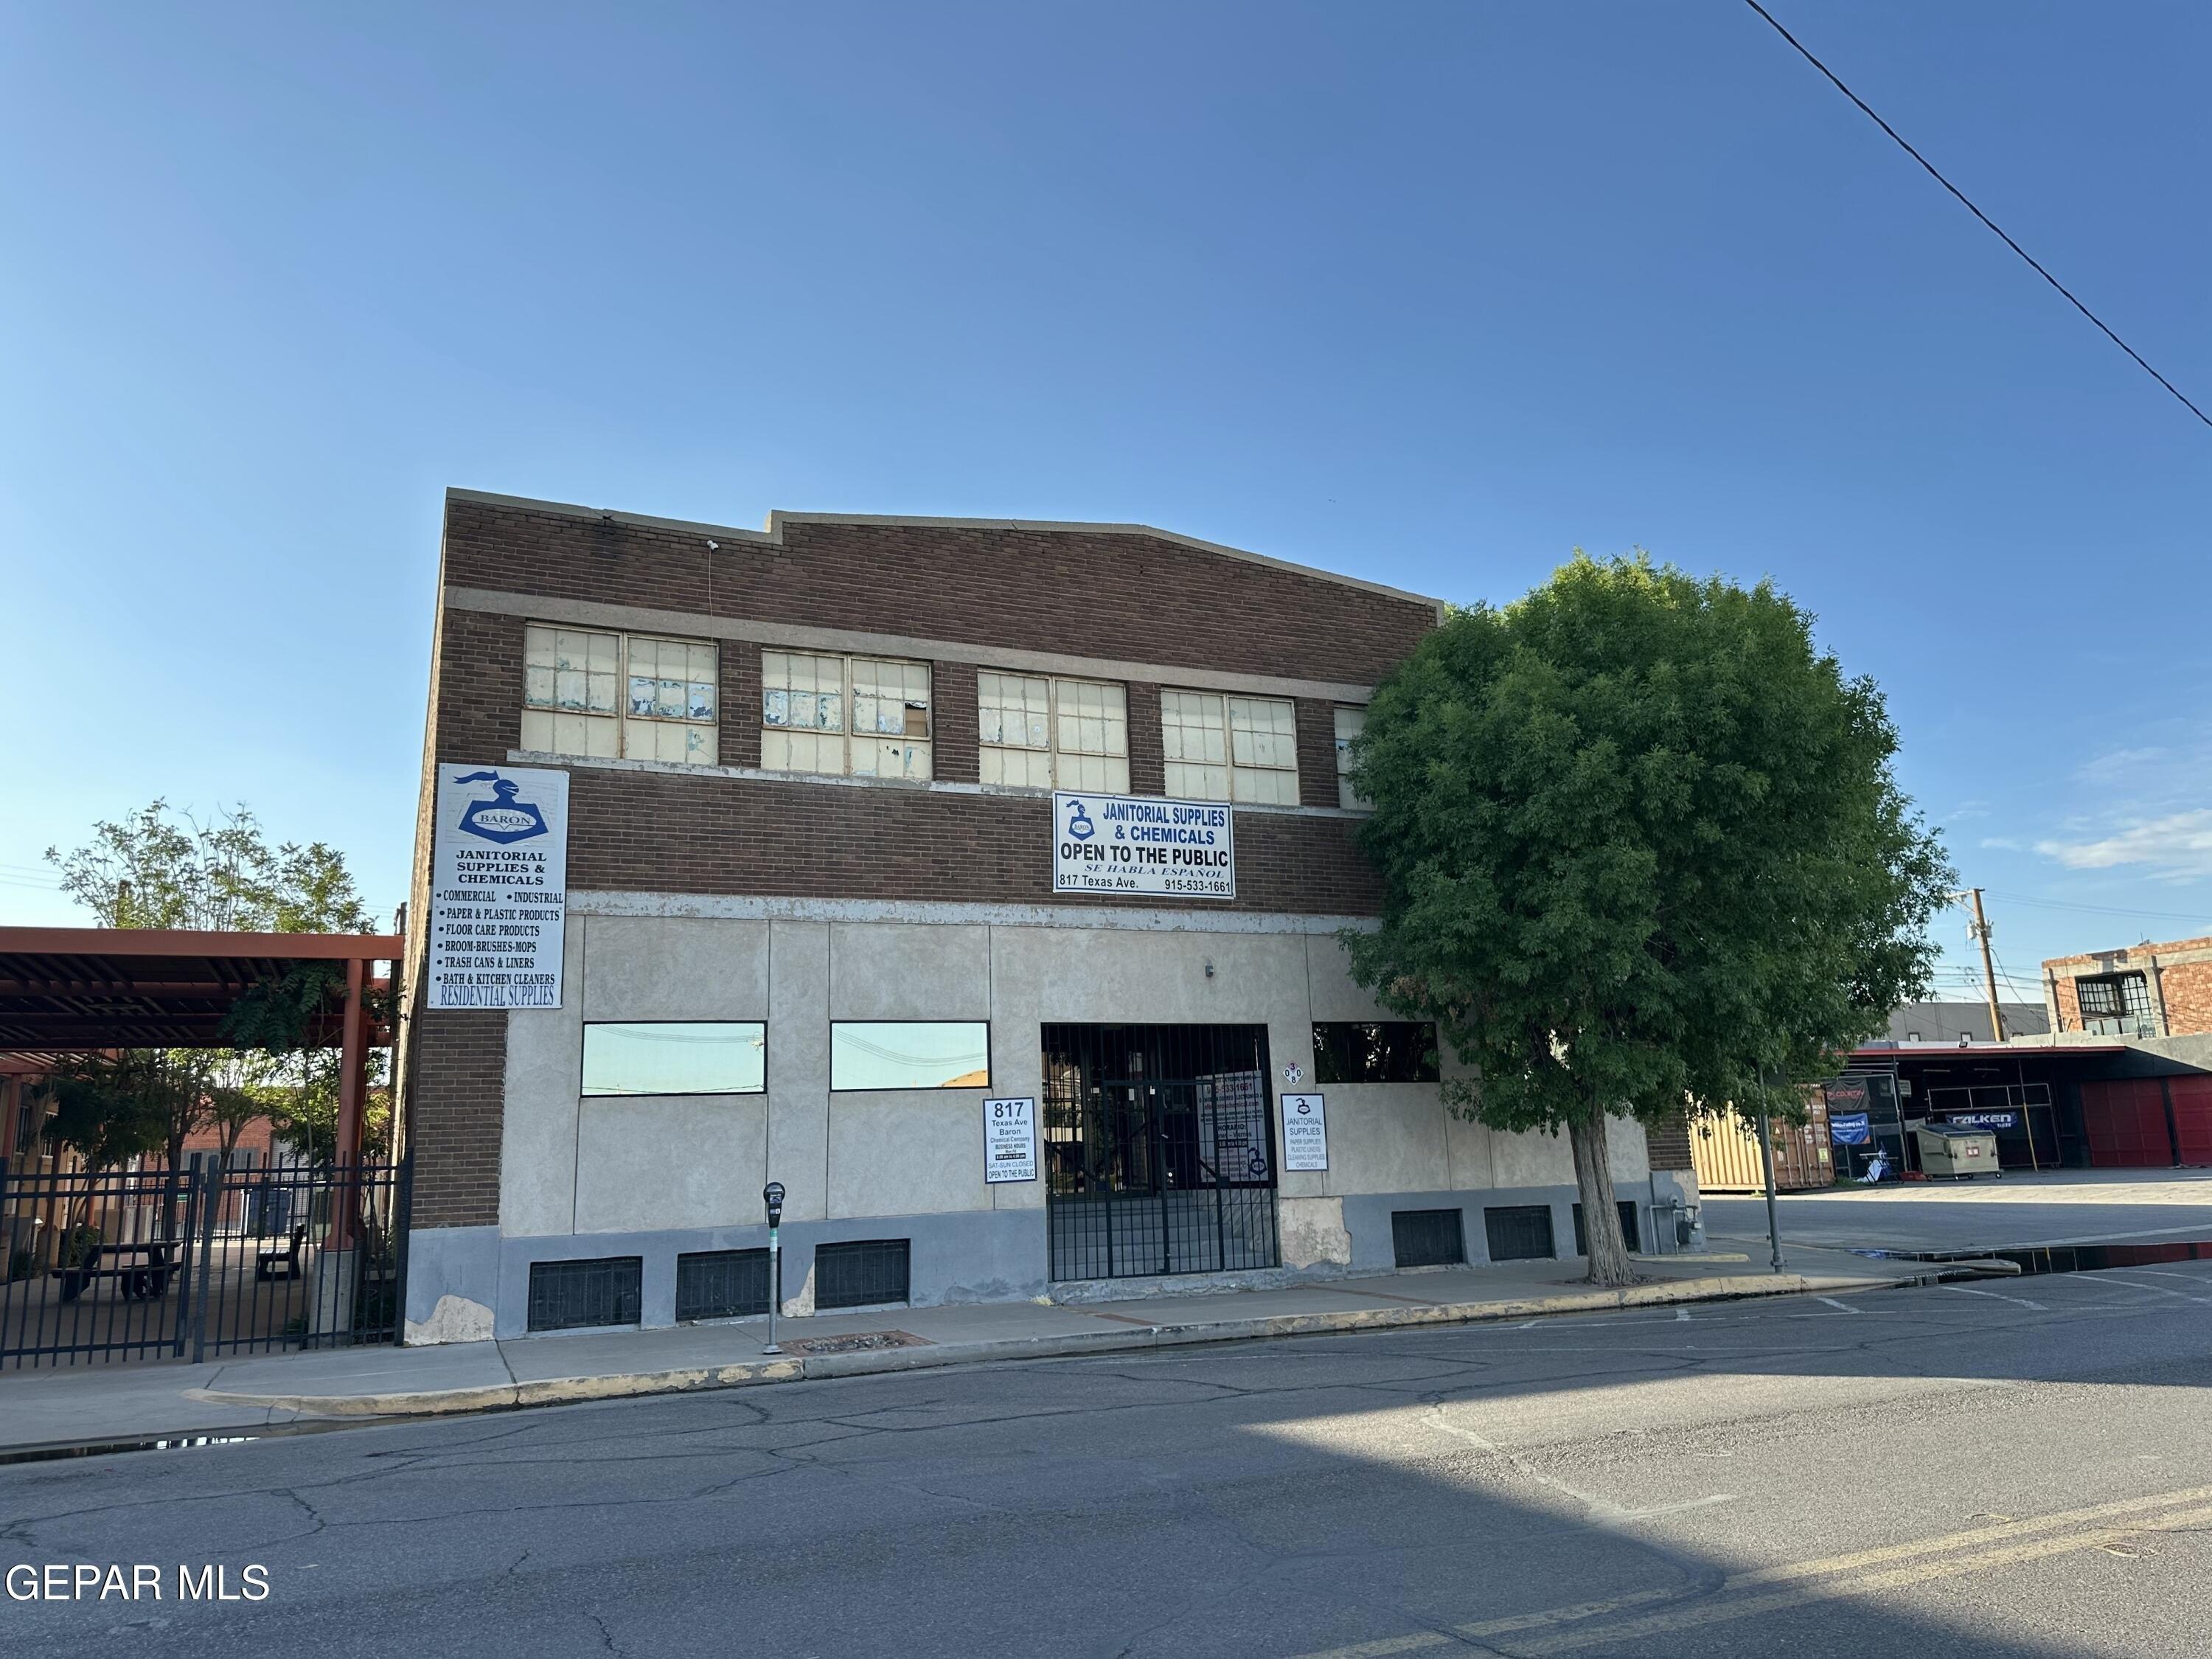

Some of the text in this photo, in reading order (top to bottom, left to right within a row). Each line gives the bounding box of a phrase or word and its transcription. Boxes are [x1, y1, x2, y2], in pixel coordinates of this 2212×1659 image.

[480, 813, 531, 825] BARON
[1103, 803, 1224, 827] JANITORIAL SUPPLIES
[1115, 825, 1214, 845] & CHEMICALS
[456, 850, 546, 861] JANITORIAL
[1061, 843, 1228, 867] OPEN TO THE PUBLIC
[457, 863, 545, 873] SUPPLIES &
[1107, 865, 1155, 874] HABLA
[1161, 867, 1224, 878] ESPAÑOL
[459, 874, 543, 885] CHEMICALS
[1060, 874, 1230, 892] 817 Texas Ave. 915-533-1661
[444, 890, 563, 904] COMMERCIAL INDUSTRIAL
[447, 908, 560, 921] PAPER & PLASTIC PRODUCTS
[447, 925, 540, 936] FLOOR CARE PRODUCTS
[445, 941, 536, 952] BROOM-BRUSHES-MOPS
[445, 957, 534, 968] TRASH CANS & LINERS
[443, 974, 554, 984] BATH & KITCHEN CLEANERS
[441, 985, 554, 1006] RESIDENTIAL SUPPLIES
[995, 1102, 1023, 1118] 817
[1952, 1114, 2011, 1124] FALKEN
[989, 1171, 1001, 1179] OPEN
[1002, 1170, 1007, 1178] TO
[1018, 1169, 1034, 1177] PUBLIC
